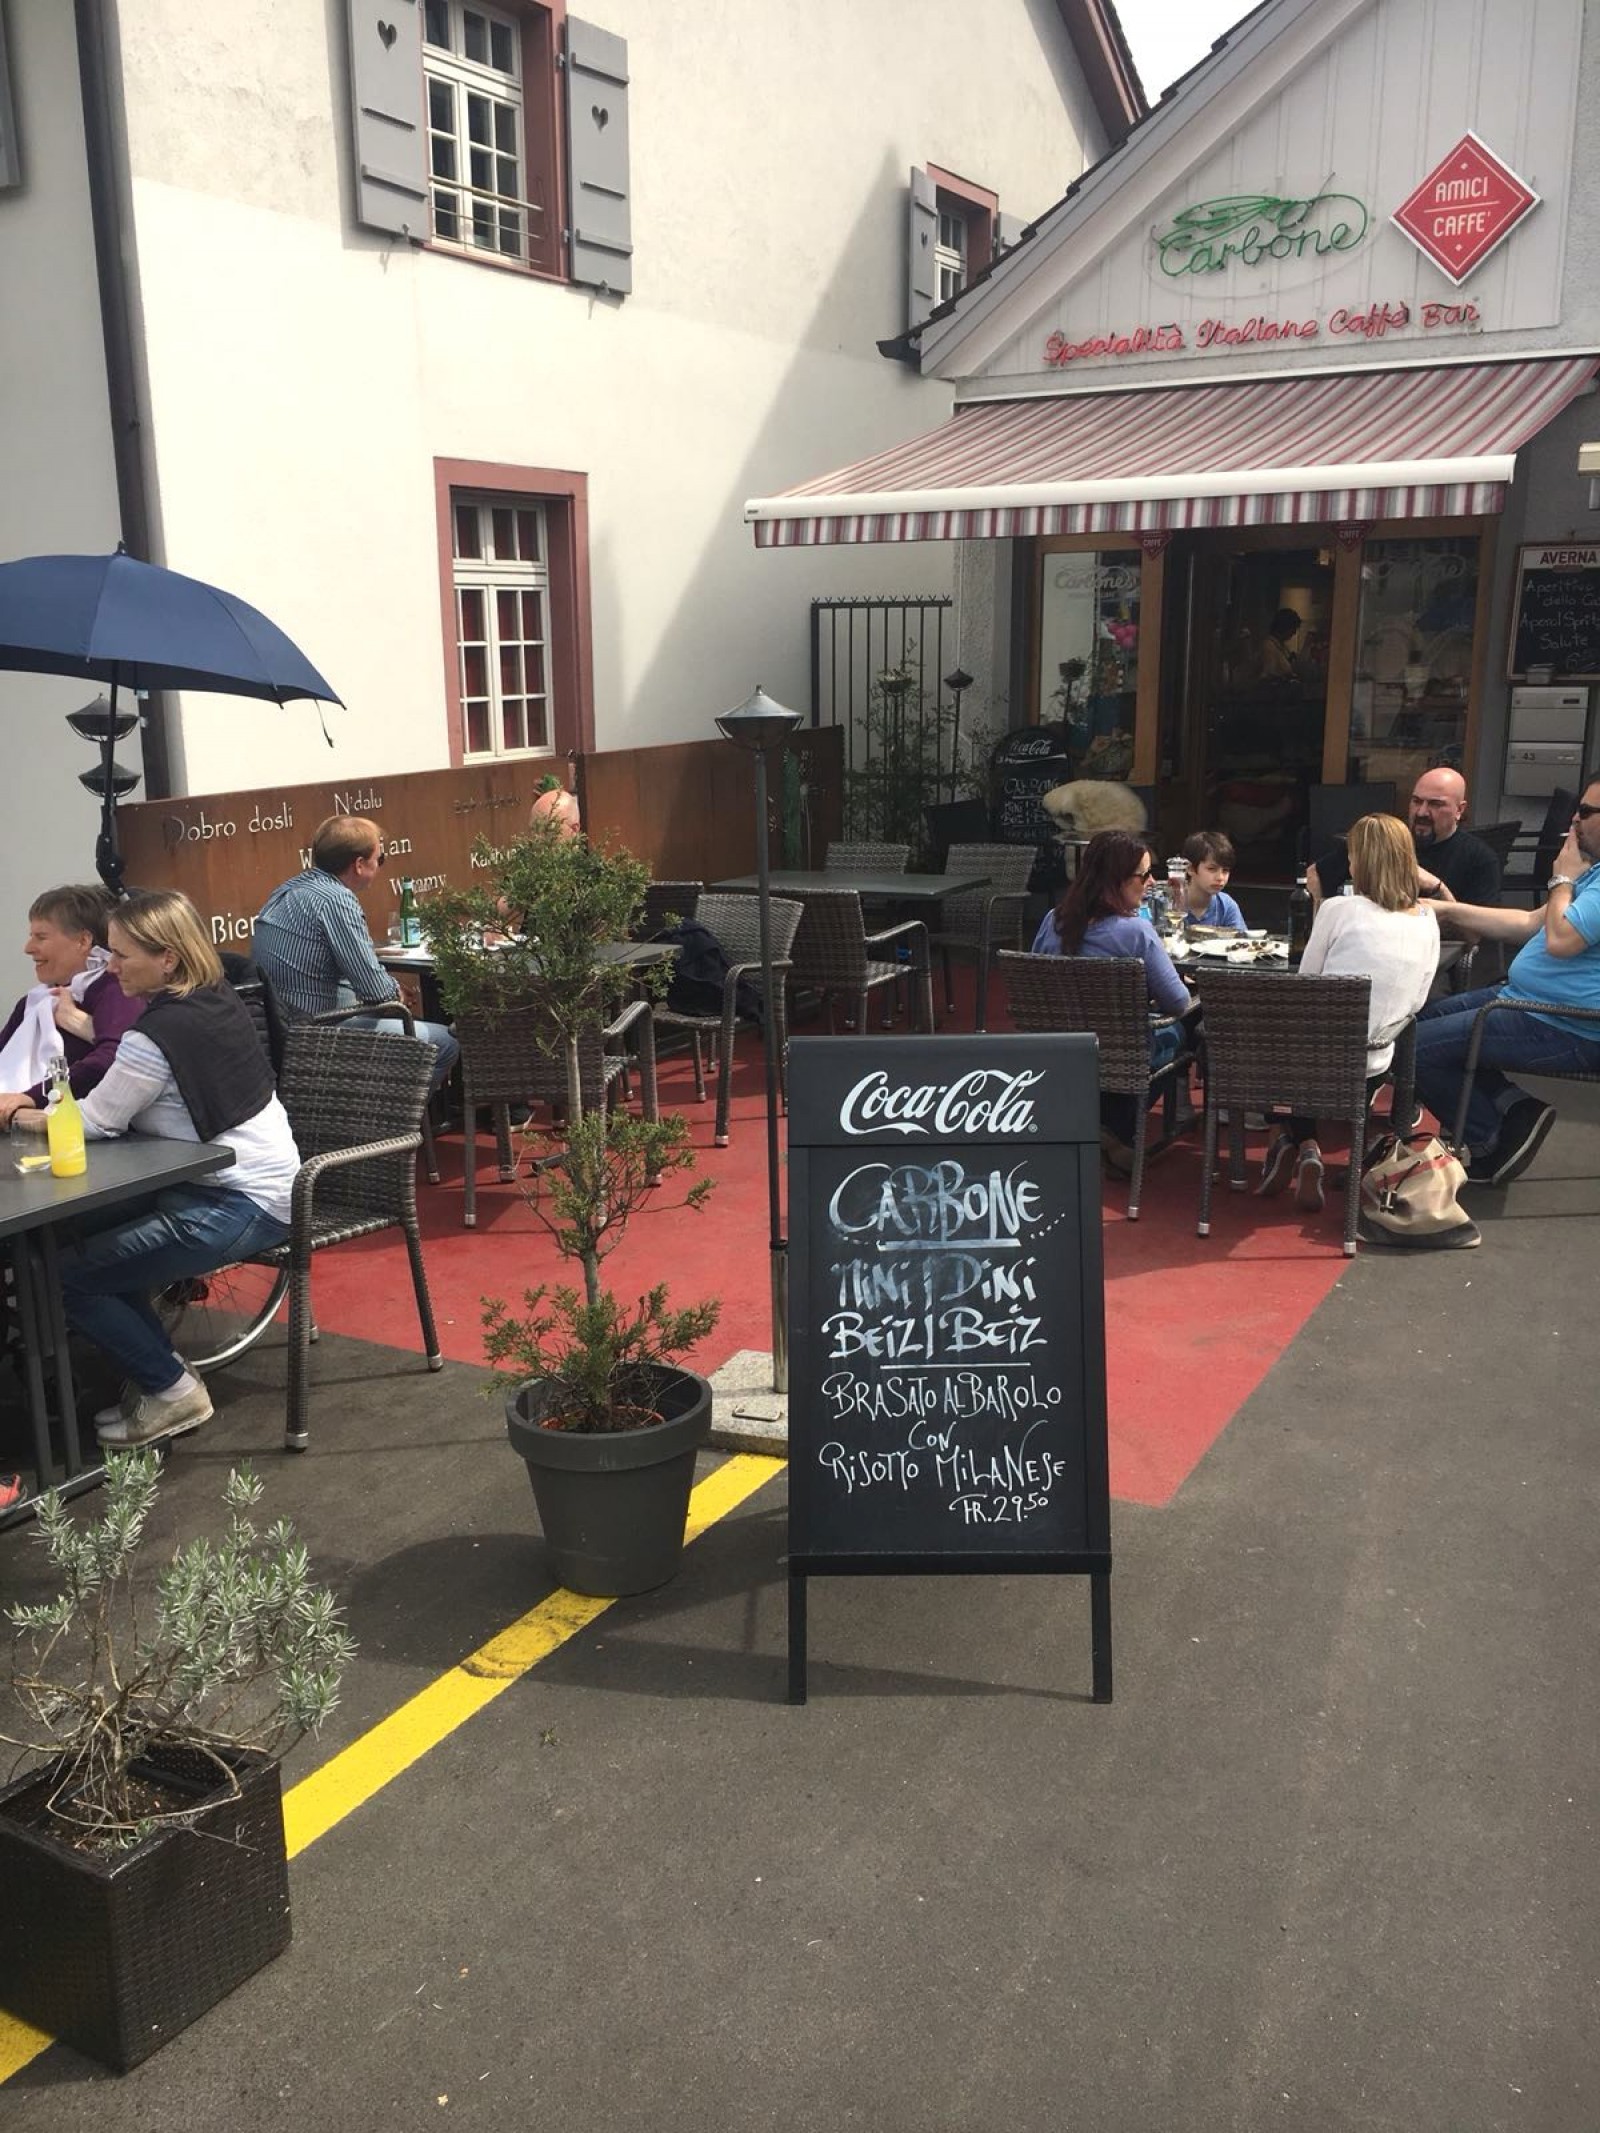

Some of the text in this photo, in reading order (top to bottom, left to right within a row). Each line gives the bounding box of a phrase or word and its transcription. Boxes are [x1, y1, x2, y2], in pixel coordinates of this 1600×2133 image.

[1435, 176, 1488, 203] AMICI
[1158, 215, 1366, 277] Carbone
[1421, 303, 1481, 329] Bar
[1539, 551, 1598, 565] AVERNA
[1540, 632, 1589, 650] Salute
[840, 1069, 1045, 1136] Coca-Cola
[829, 1160, 1044, 1241] CARBONE
[821, 1371, 1062, 1421] BRASATO AL BAROLO
